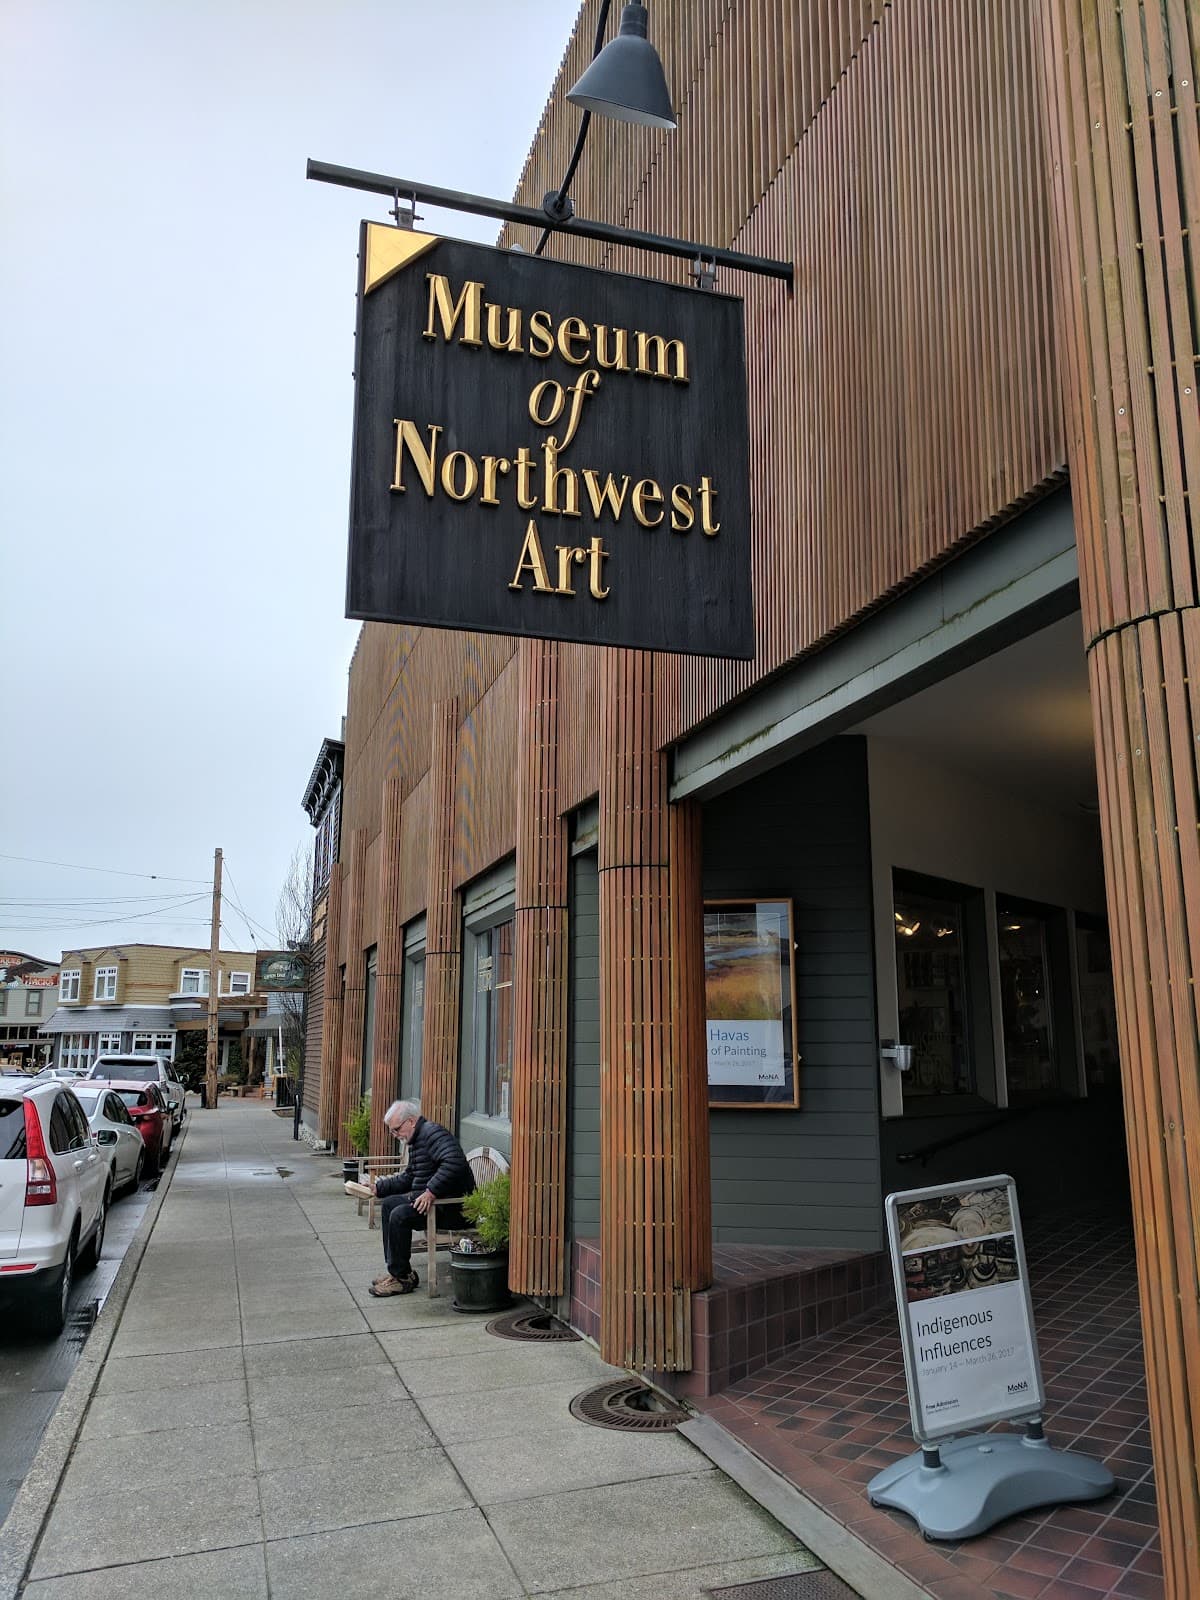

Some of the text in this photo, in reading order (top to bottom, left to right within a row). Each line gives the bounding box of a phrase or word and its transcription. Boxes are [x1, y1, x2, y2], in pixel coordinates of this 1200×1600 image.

[422, 272, 690, 385] Museum
[528, 369, 600, 451] of
[389, 418, 721, 536] Northwest
[508, 519, 610, 600] Art
[710, 1028, 750, 1041] Havas
[711, 1046, 767, 1057] of Painting
[917, 1309, 993, 1337] Indigenous
[920, 1335, 992, 1362] Influences
[921, 1363, 948, 1376] January
[965, 1355, 987, 1367] March
[1007, 1381, 1028, 1392] MoNA
